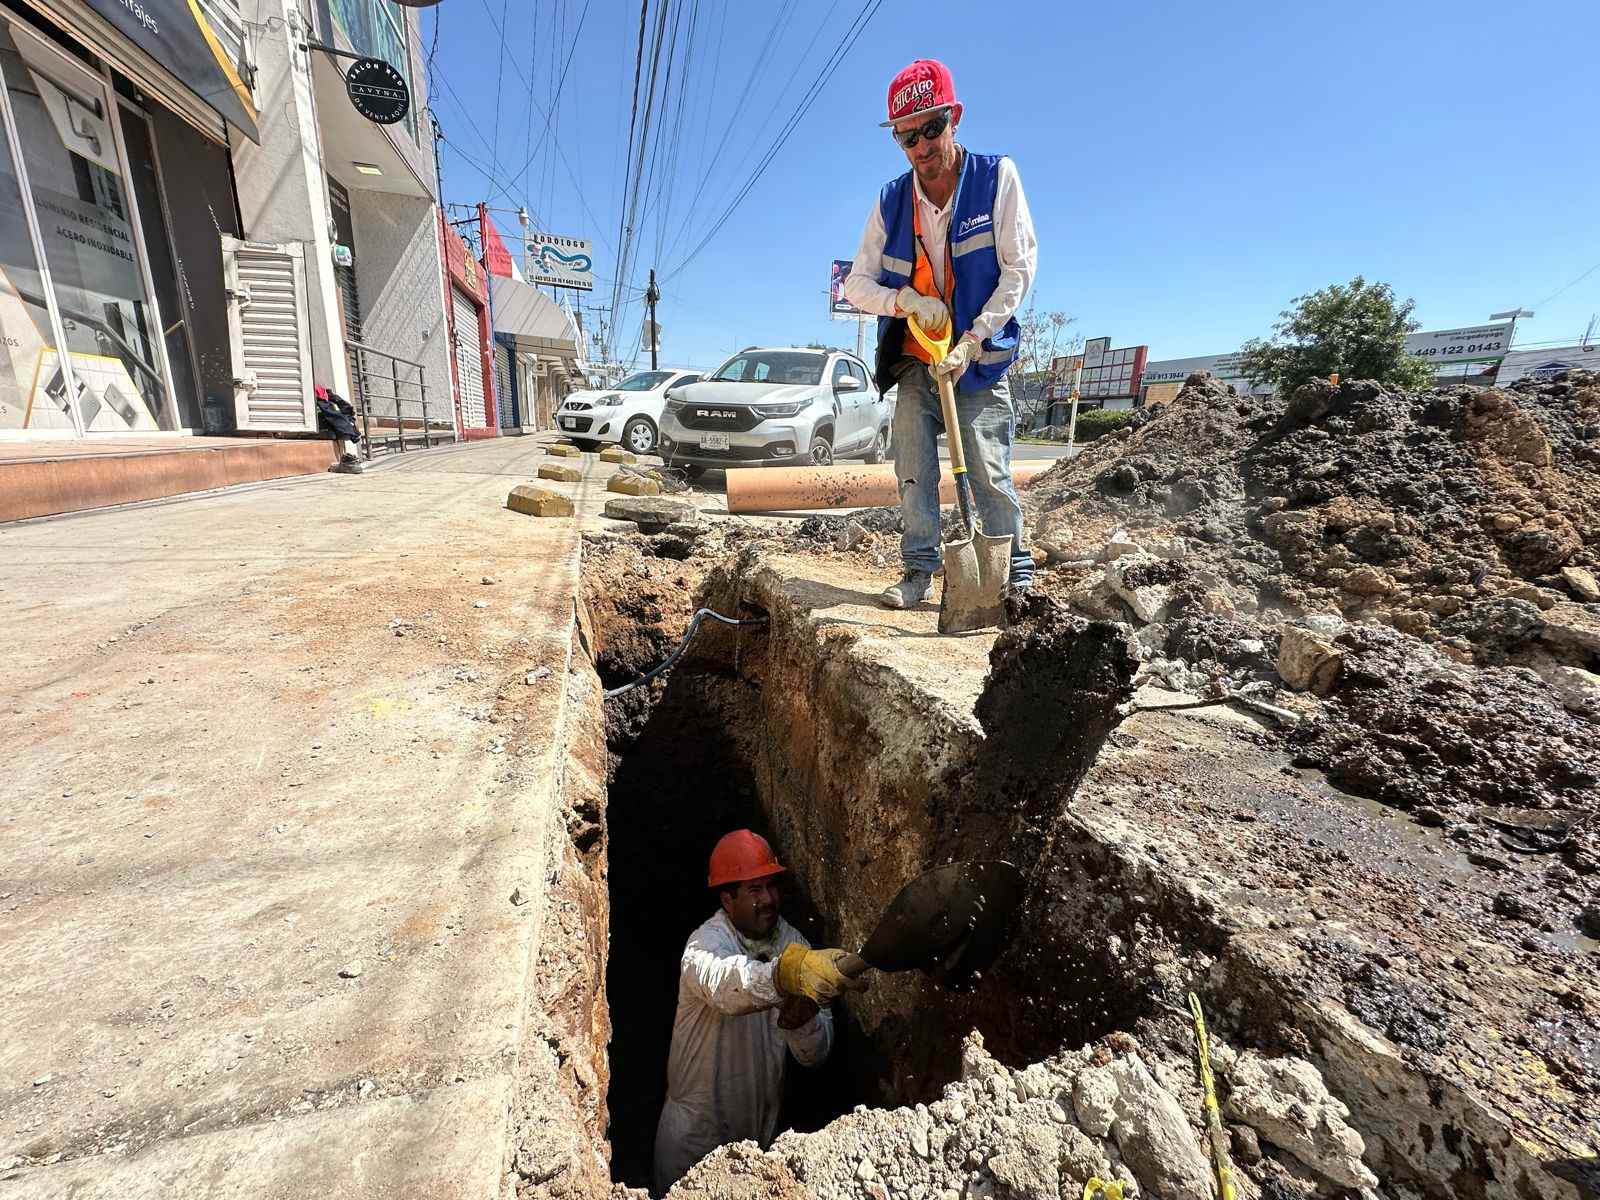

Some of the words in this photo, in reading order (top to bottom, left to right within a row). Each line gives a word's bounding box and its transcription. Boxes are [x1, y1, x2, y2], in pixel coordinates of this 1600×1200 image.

[386, 68, 403, 86] RED
[892, 79, 933, 114] CHICAGO
[912, 91, 935, 113] 23
[354, 97, 364, 108] DE
[365, 108, 389, 121] VENTA
[56, 225, 86, 244] ACERO
[1415, 347, 1437, 356] 449
[1441, 345, 1464, 355] 122
[1467, 342, 1502, 353] 0143
[696, 409, 737, 418] RAM
